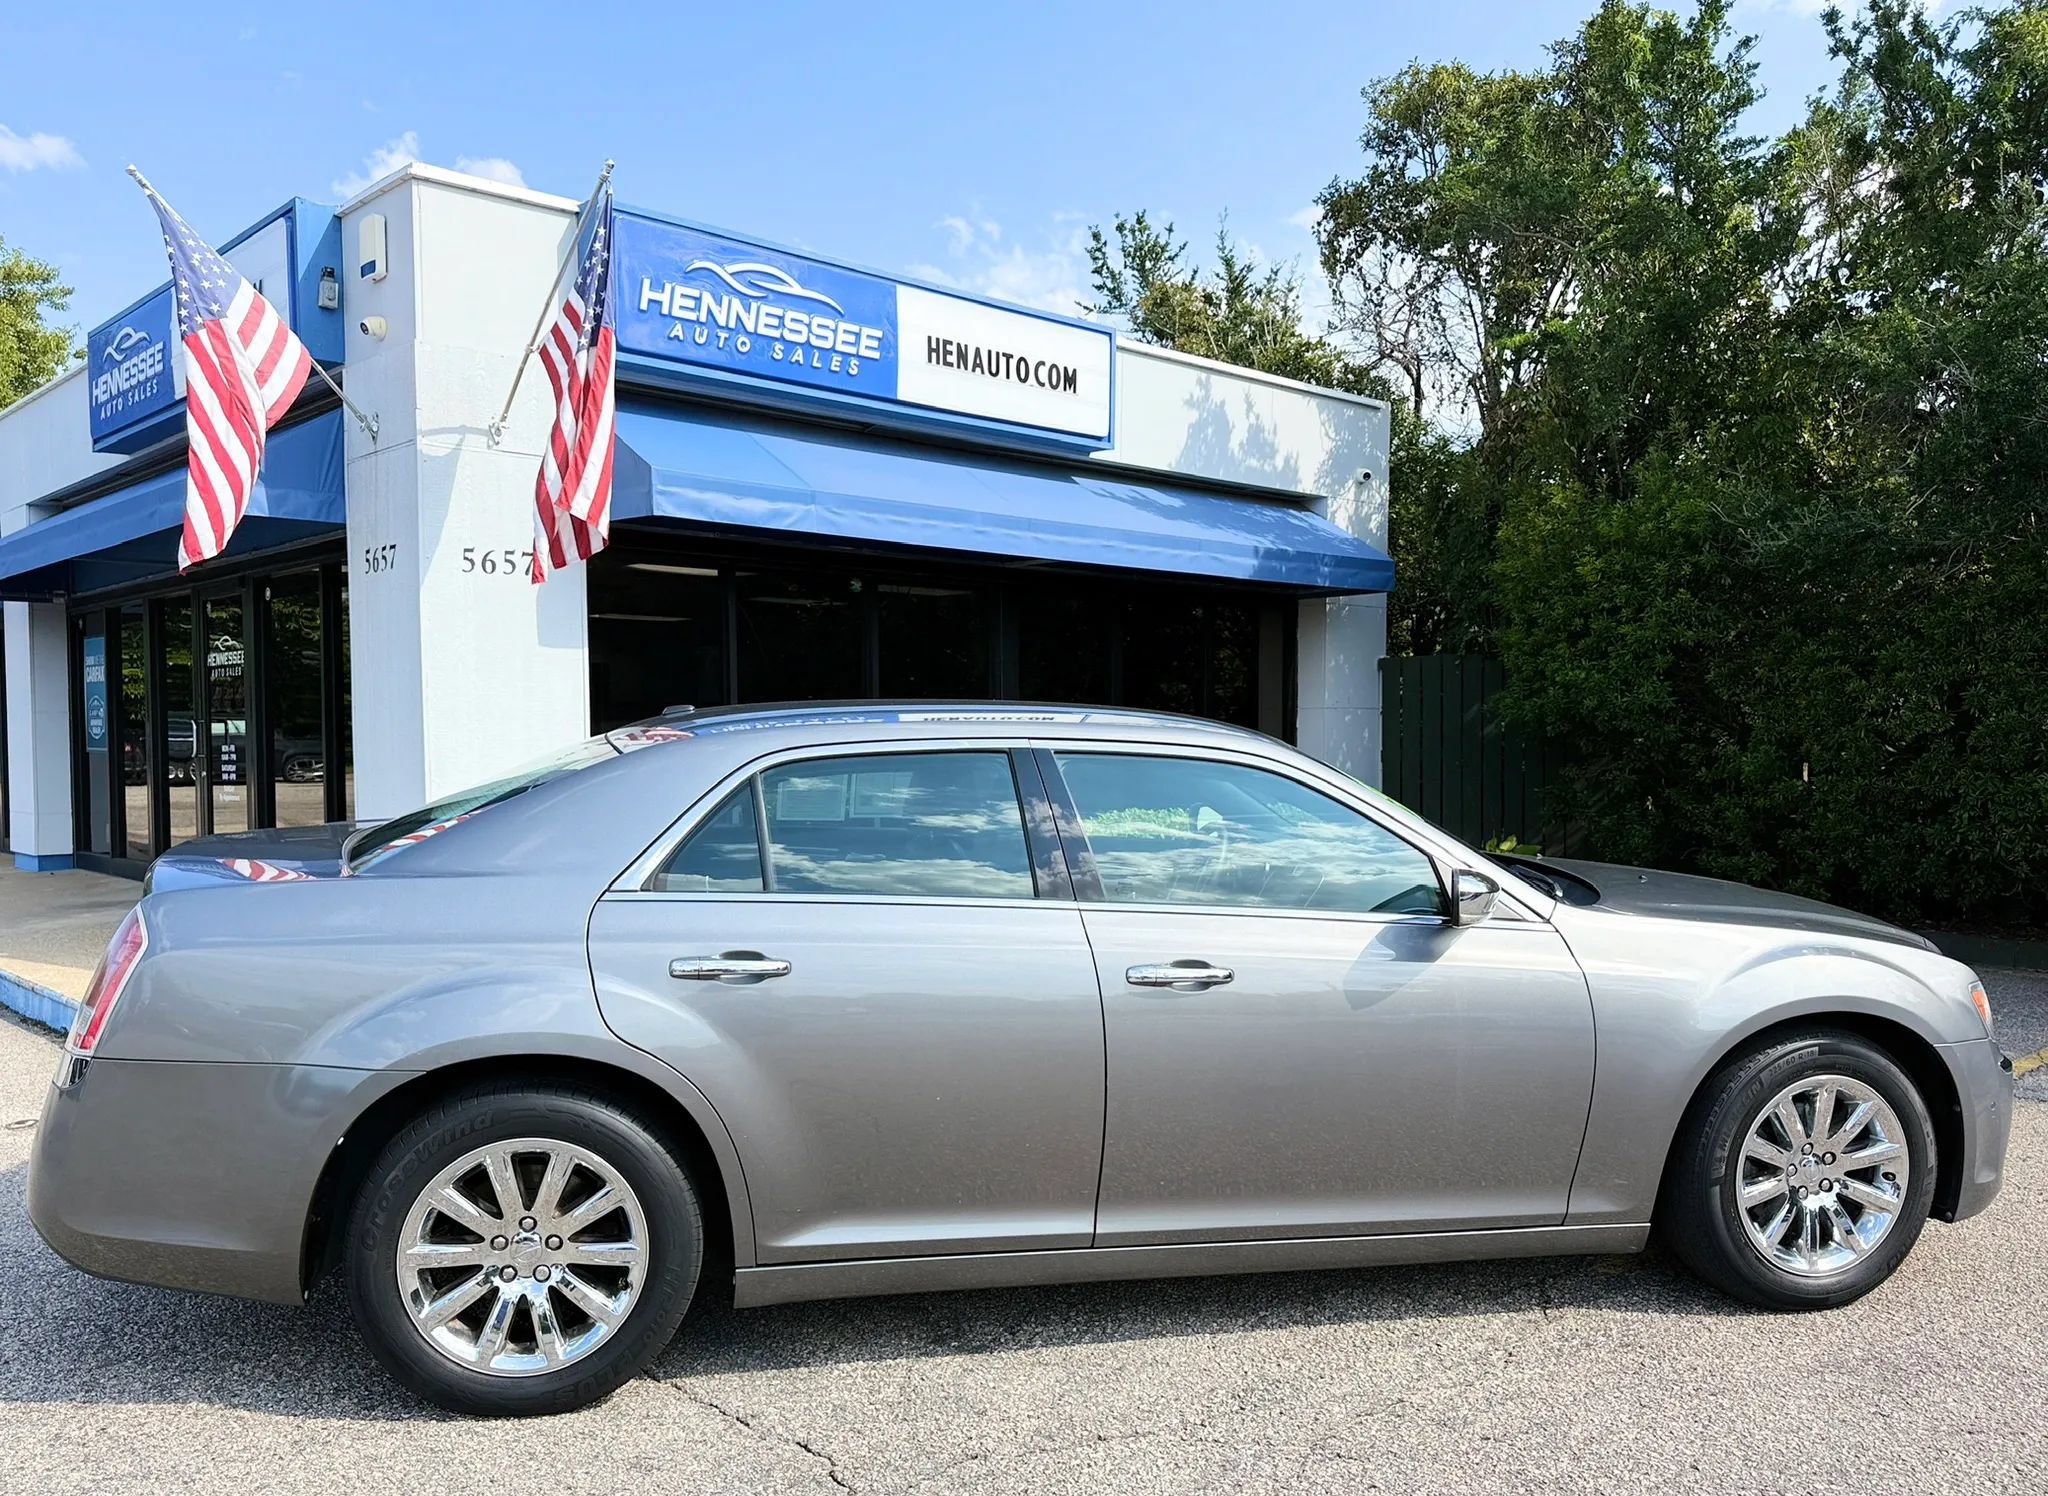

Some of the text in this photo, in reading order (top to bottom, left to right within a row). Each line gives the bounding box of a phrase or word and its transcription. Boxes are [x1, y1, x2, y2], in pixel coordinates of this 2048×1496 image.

[639, 277, 884, 361] HENNESSEE
[669, 321, 860, 377] AUTO SALES
[92, 340, 165, 408] HENNESSEE
[100, 378, 158, 421] AUTO SALES
[364, 543, 397, 575] 5657
[461, 546, 535, 577] 5657
[207, 650, 245, 667] HENNESSEE
[211, 666, 242, 678] AUTO SALES
